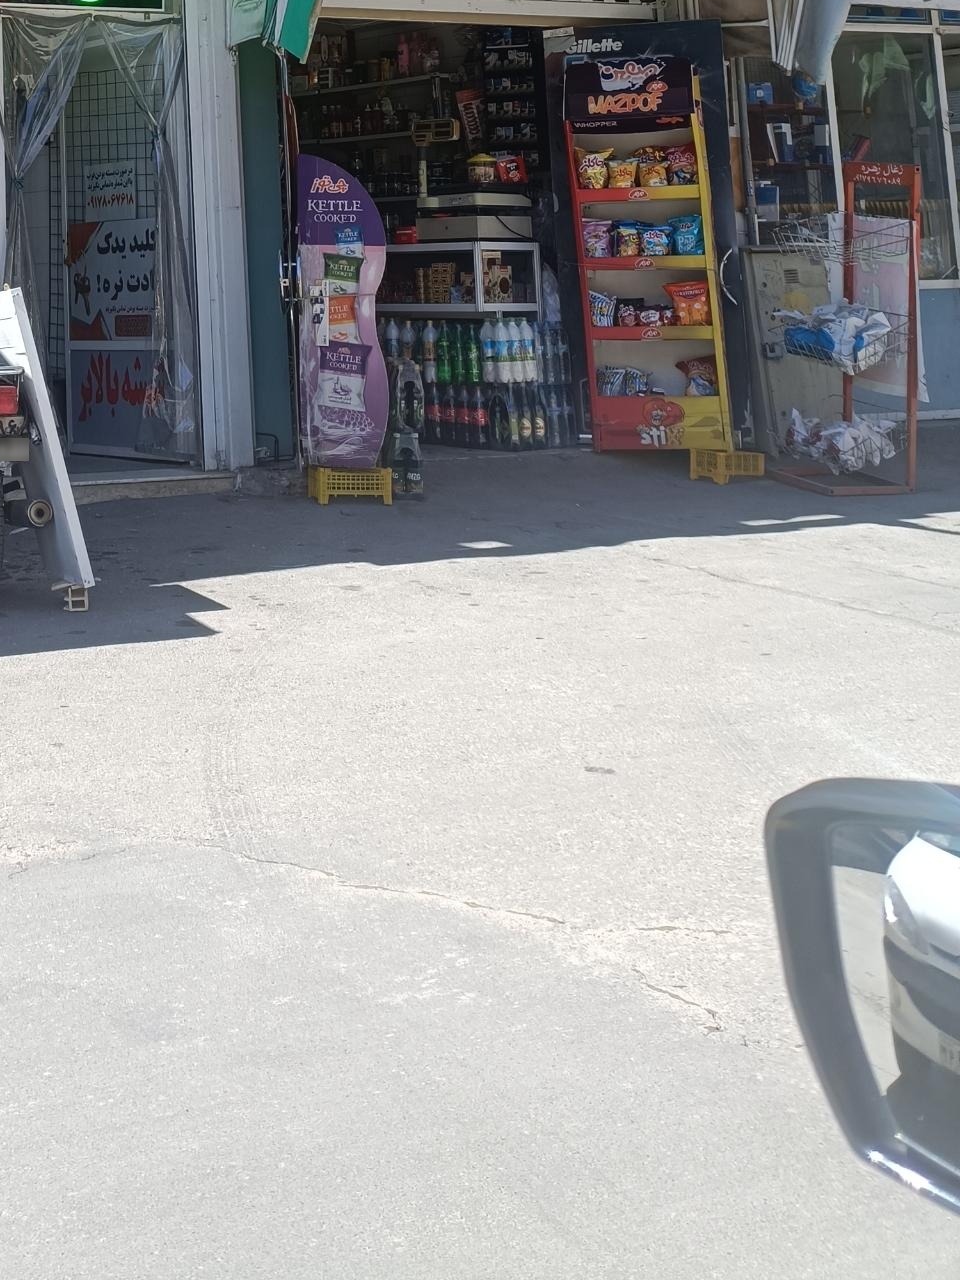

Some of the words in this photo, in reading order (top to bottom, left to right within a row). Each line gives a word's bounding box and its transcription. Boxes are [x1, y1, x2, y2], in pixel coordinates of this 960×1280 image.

[566, 38, 622, 54] Gillette
[587, 92, 663, 115] MAZPOF
[307, 200, 363, 212] KETTLE
[314, 214, 357, 223] COOKED
[97, 232, 126, 259] یدک
[127, 269, 155, 292] ادت
[326, 352, 361, 364] KETTLE
[329, 362, 357, 370] COOKED
